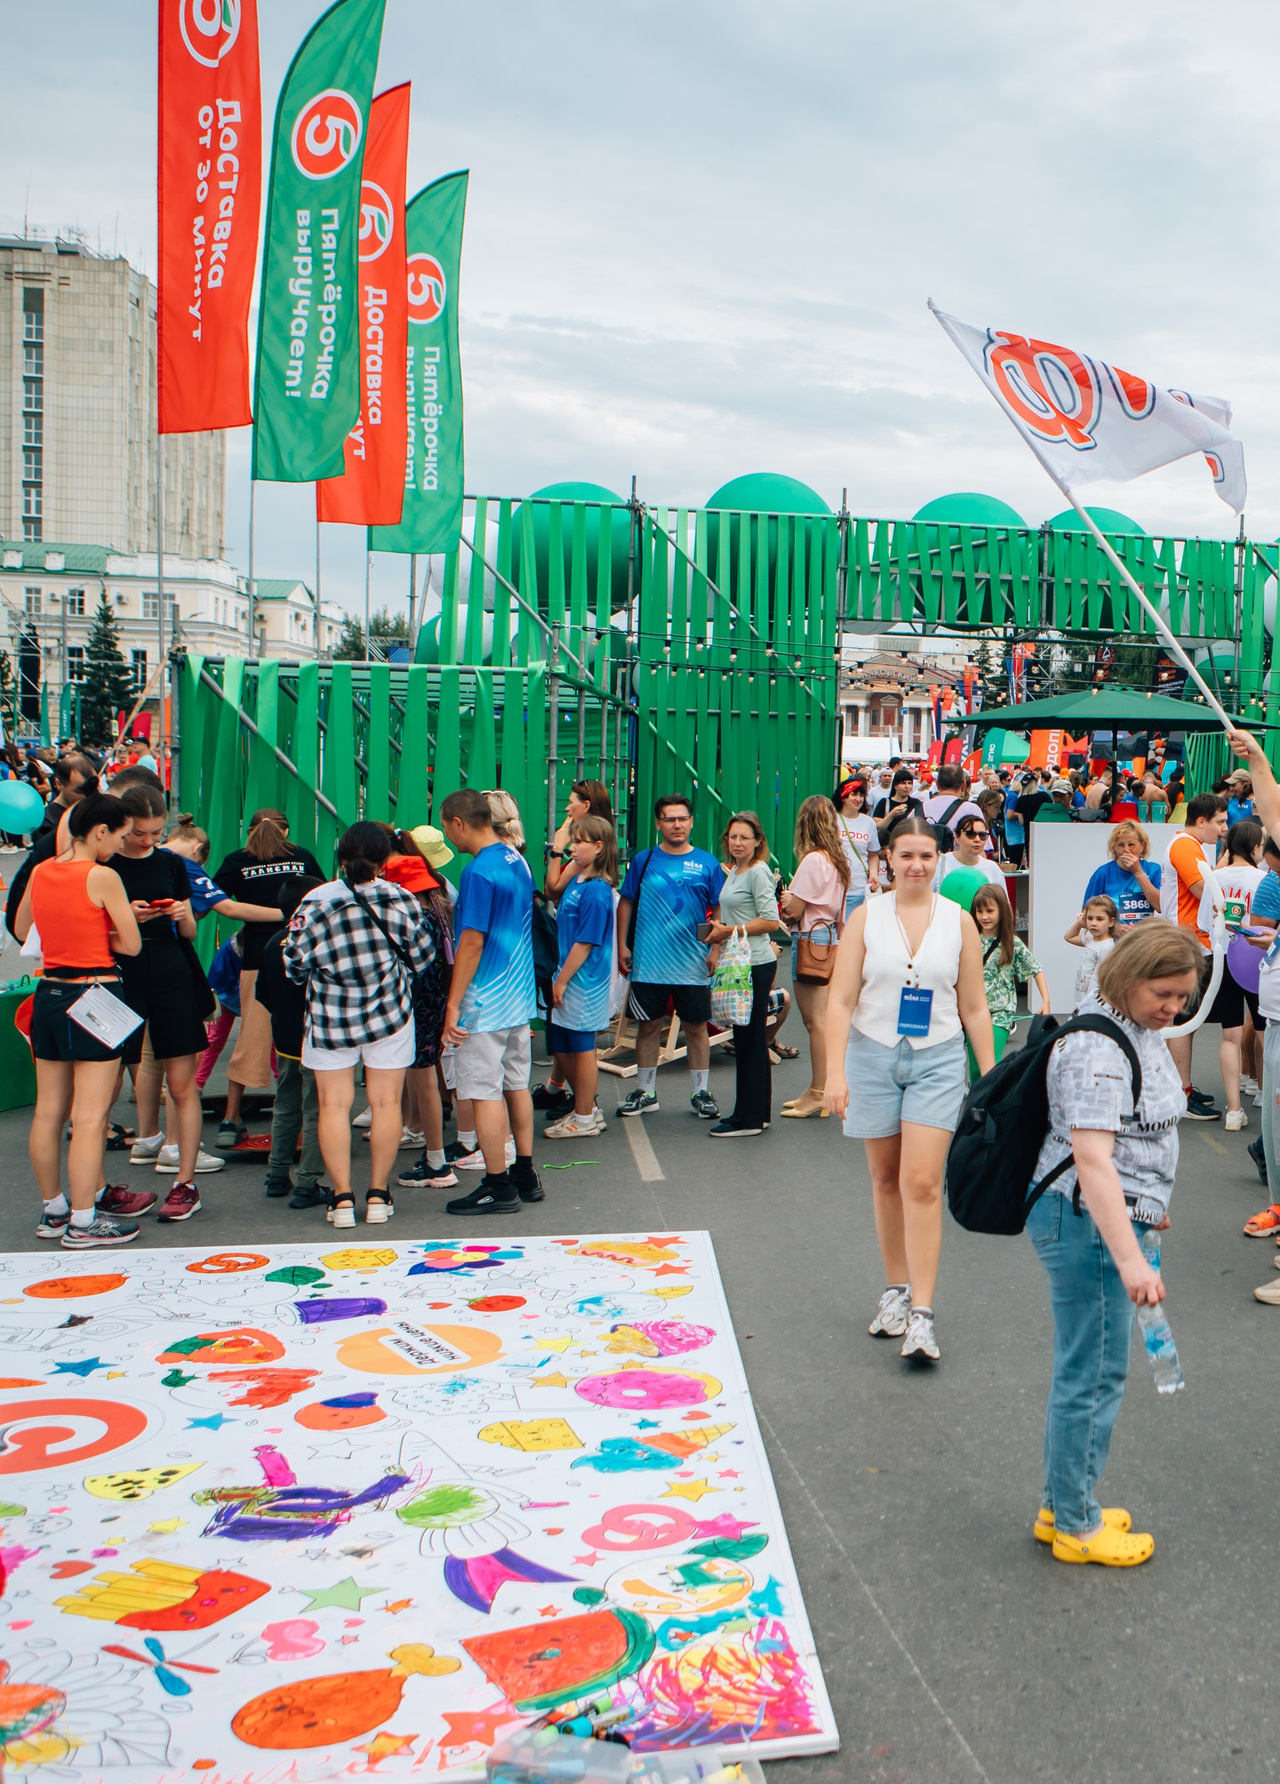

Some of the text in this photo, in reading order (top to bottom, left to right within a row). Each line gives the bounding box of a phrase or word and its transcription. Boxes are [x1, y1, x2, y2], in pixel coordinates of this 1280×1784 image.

[189, 105, 214, 342] от 30 минут
[207, 98, 241, 289] Доставка
[285, 209, 311, 399] выручает!
[311, 209, 340, 400] Пятёрочка
[364, 285, 388, 426] Доставка
[423, 346, 440, 492] Пятёрочка
[987, 743, 996, 763] 2ГИС
[1123, 900, 1150, 910] 3868
[899, 1022, 928, 1030] ПЕРСОНАЛ
[1138, 1115, 1178, 1133] MOOD
[389, 1338, 441, 1365] Держим
